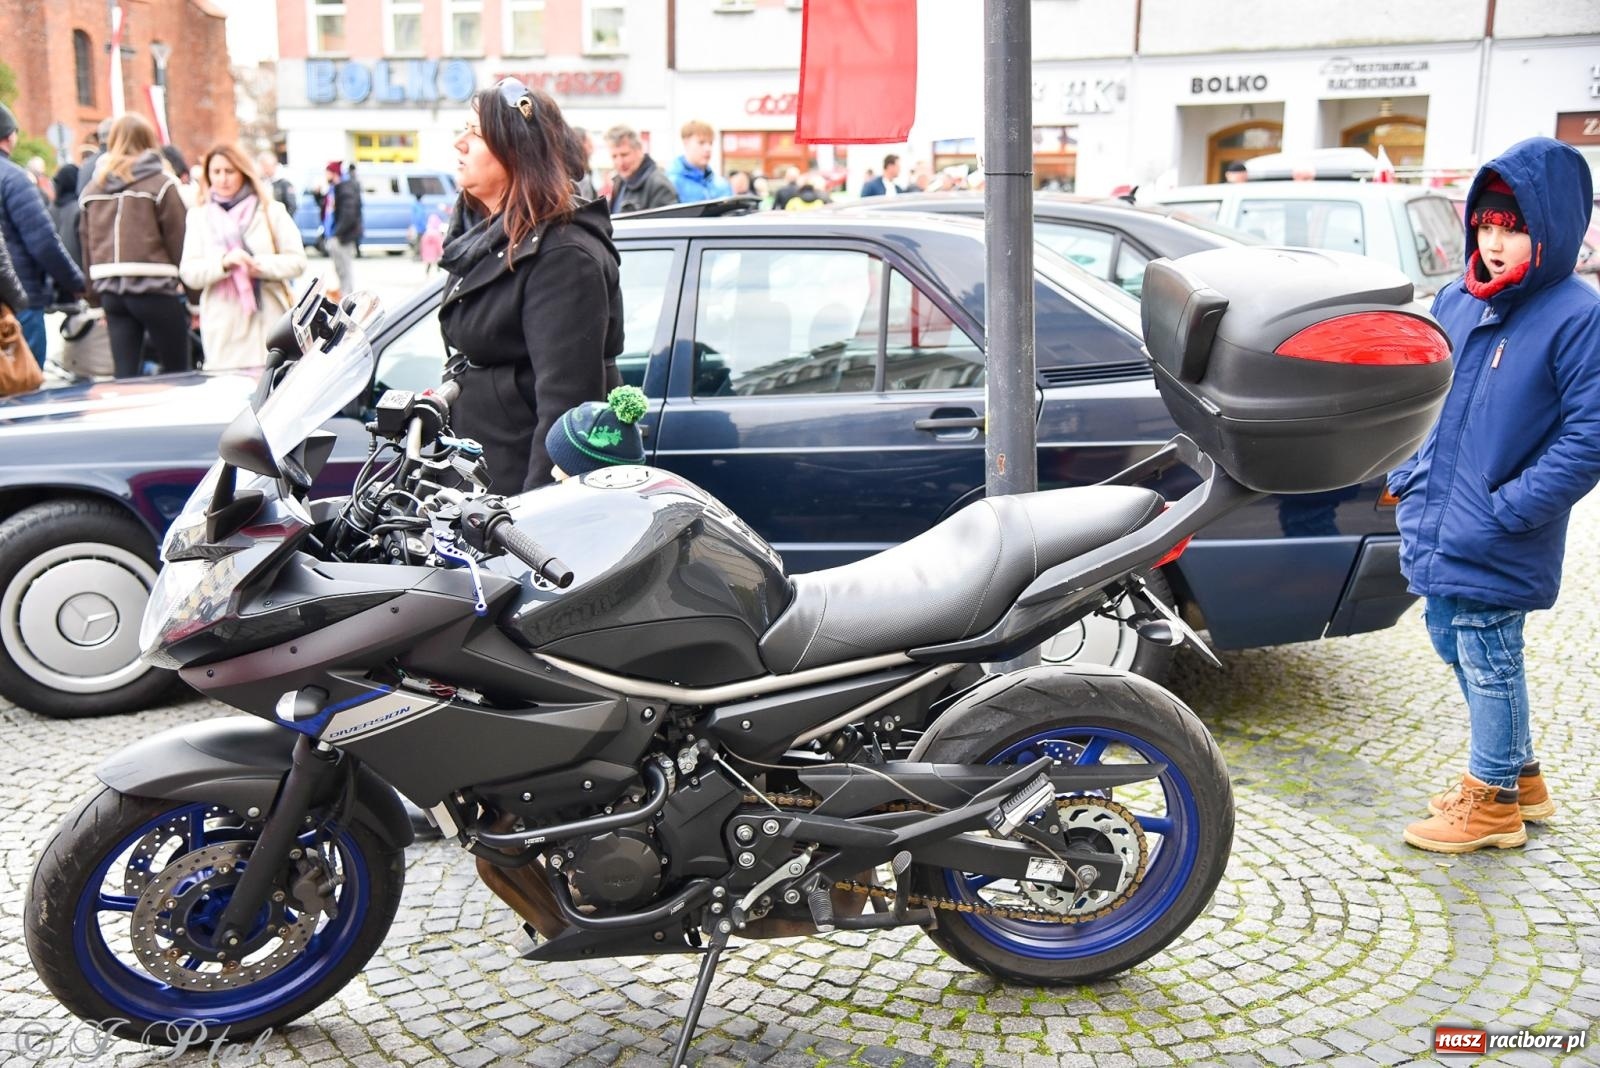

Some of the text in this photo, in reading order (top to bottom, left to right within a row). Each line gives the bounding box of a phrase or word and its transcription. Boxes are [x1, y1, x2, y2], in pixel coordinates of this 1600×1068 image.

[306, 58, 477, 103] BOLKO
[1191, 75, 1268, 94] BOLKO
[329, 706, 411, 738] DIVERSION
